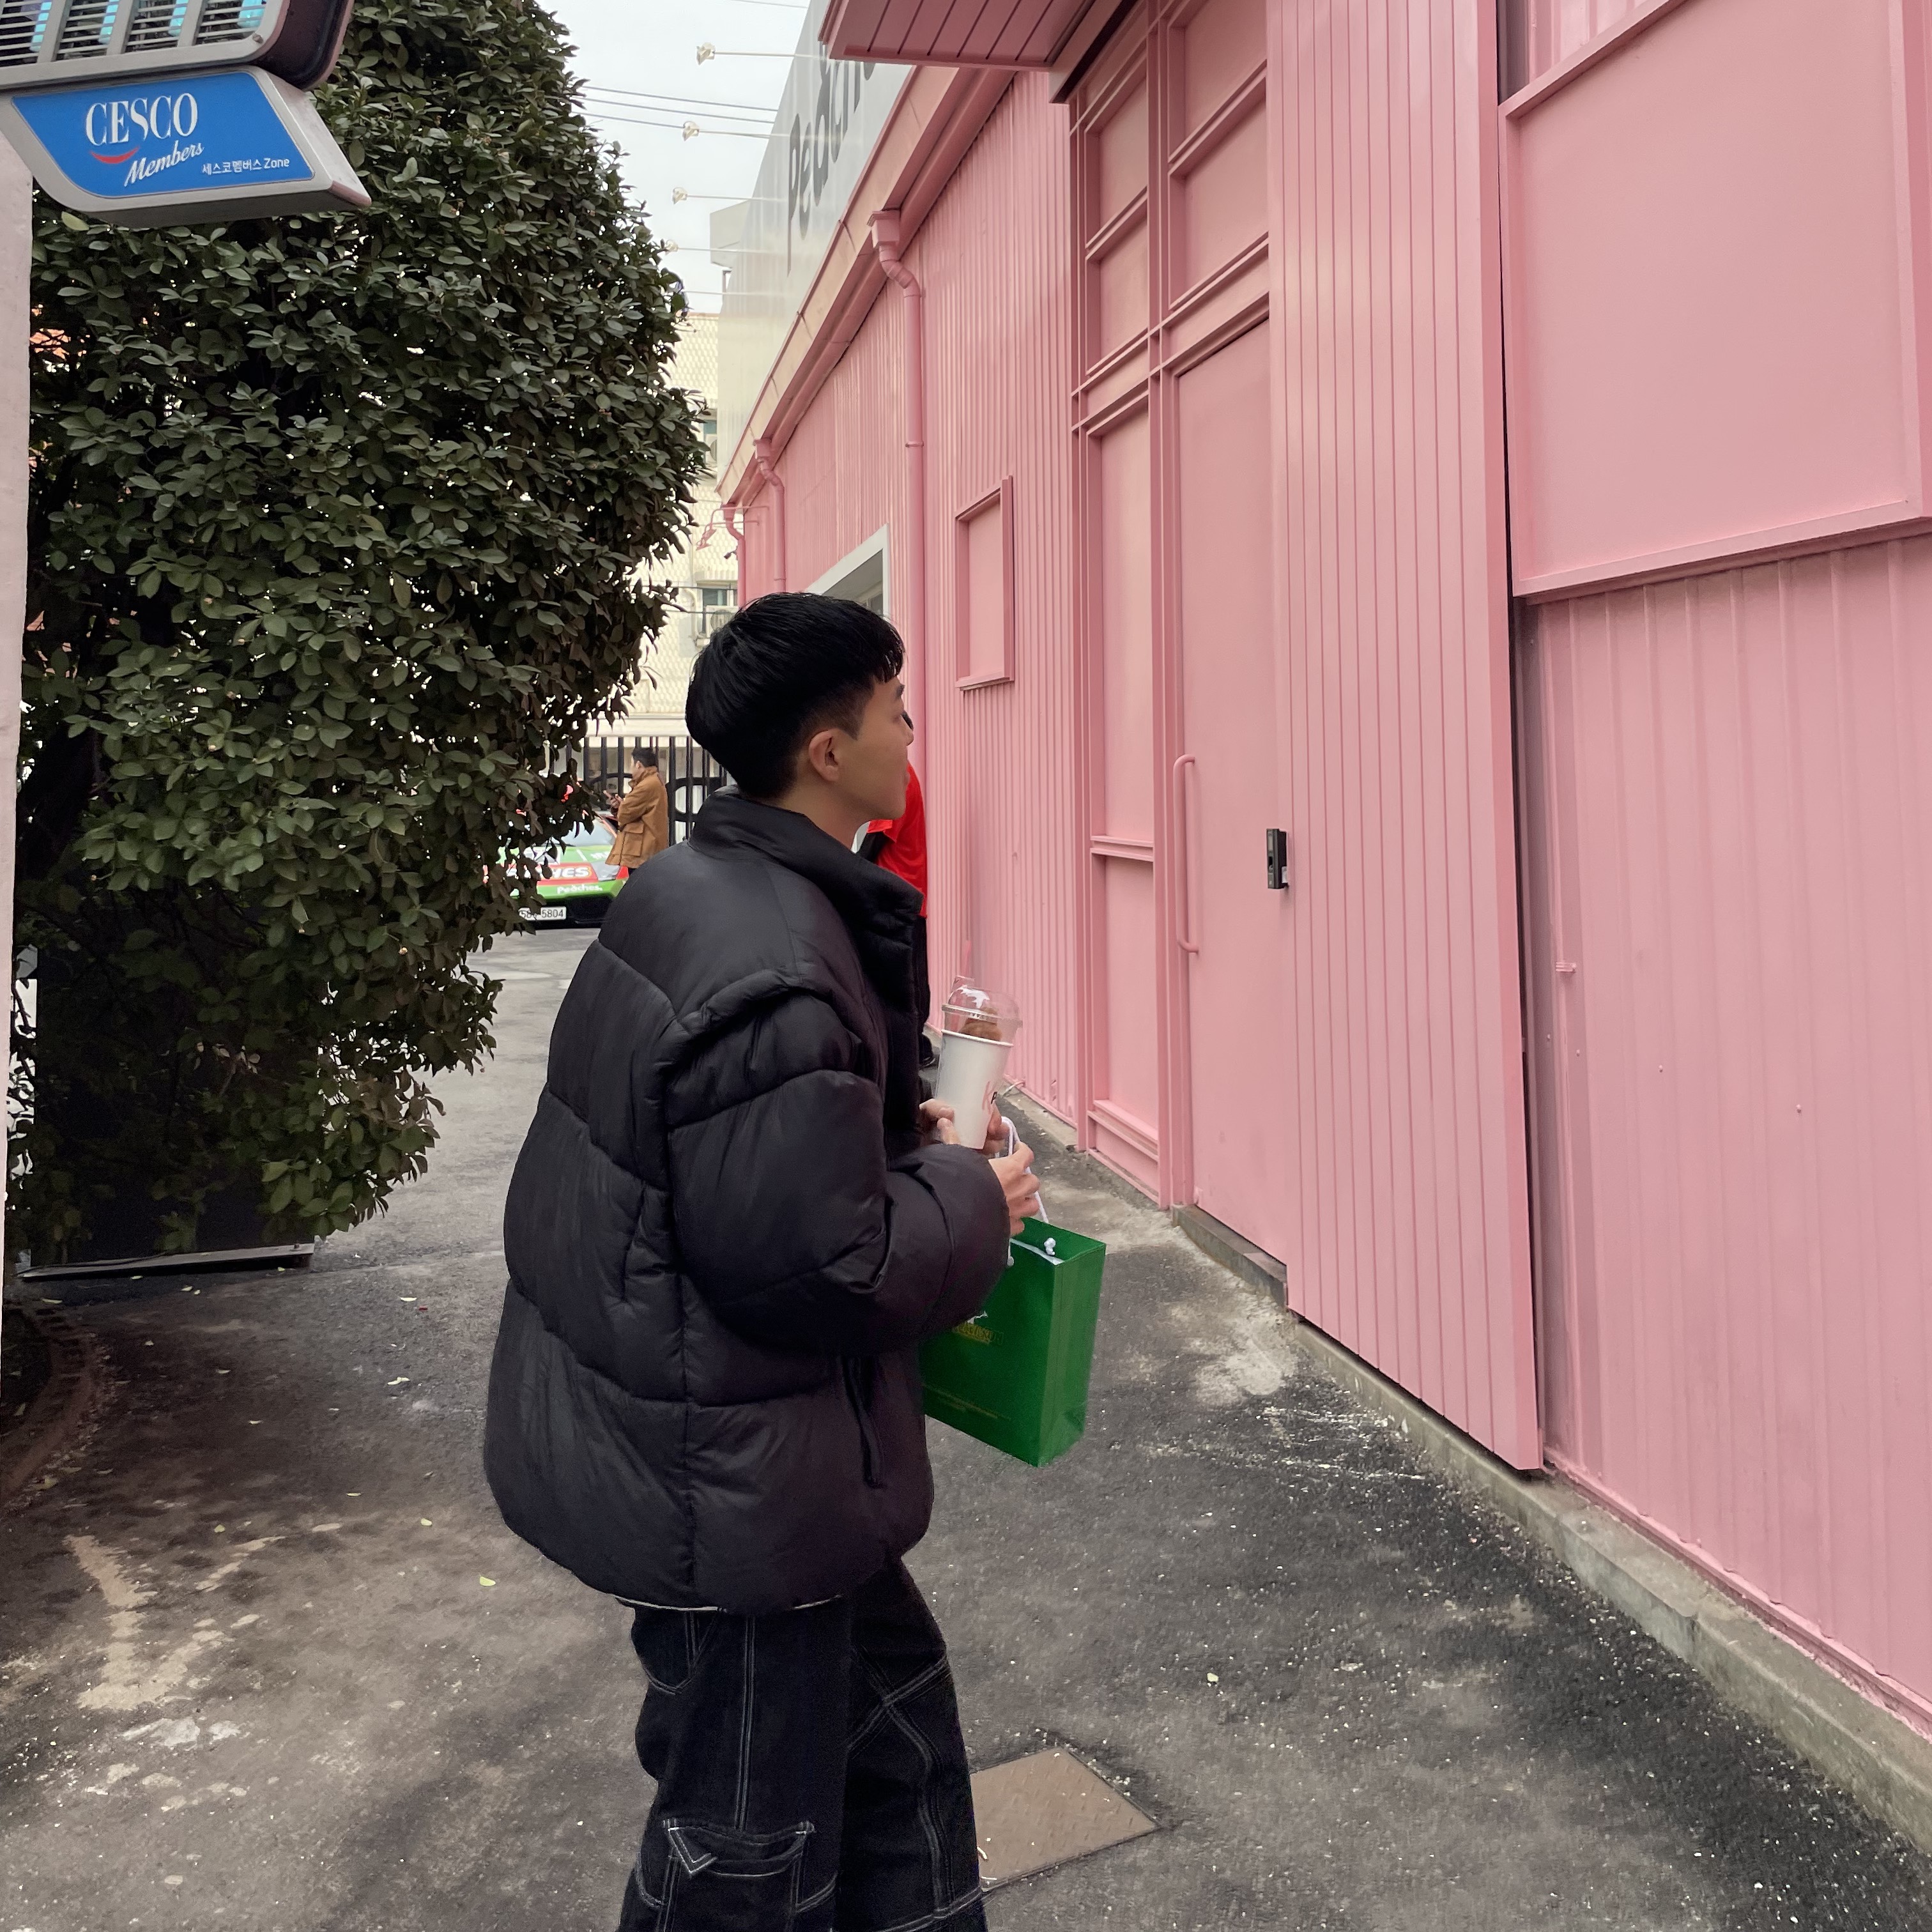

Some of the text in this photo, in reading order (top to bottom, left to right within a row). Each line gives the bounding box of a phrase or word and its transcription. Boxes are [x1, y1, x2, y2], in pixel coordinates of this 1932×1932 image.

[86, 93, 198, 146] CESCO
[123, 140, 205, 187] Members
[202, 157, 290, 176] 세스코멤버스 Zone
[541, 908, 564, 918] 5804
